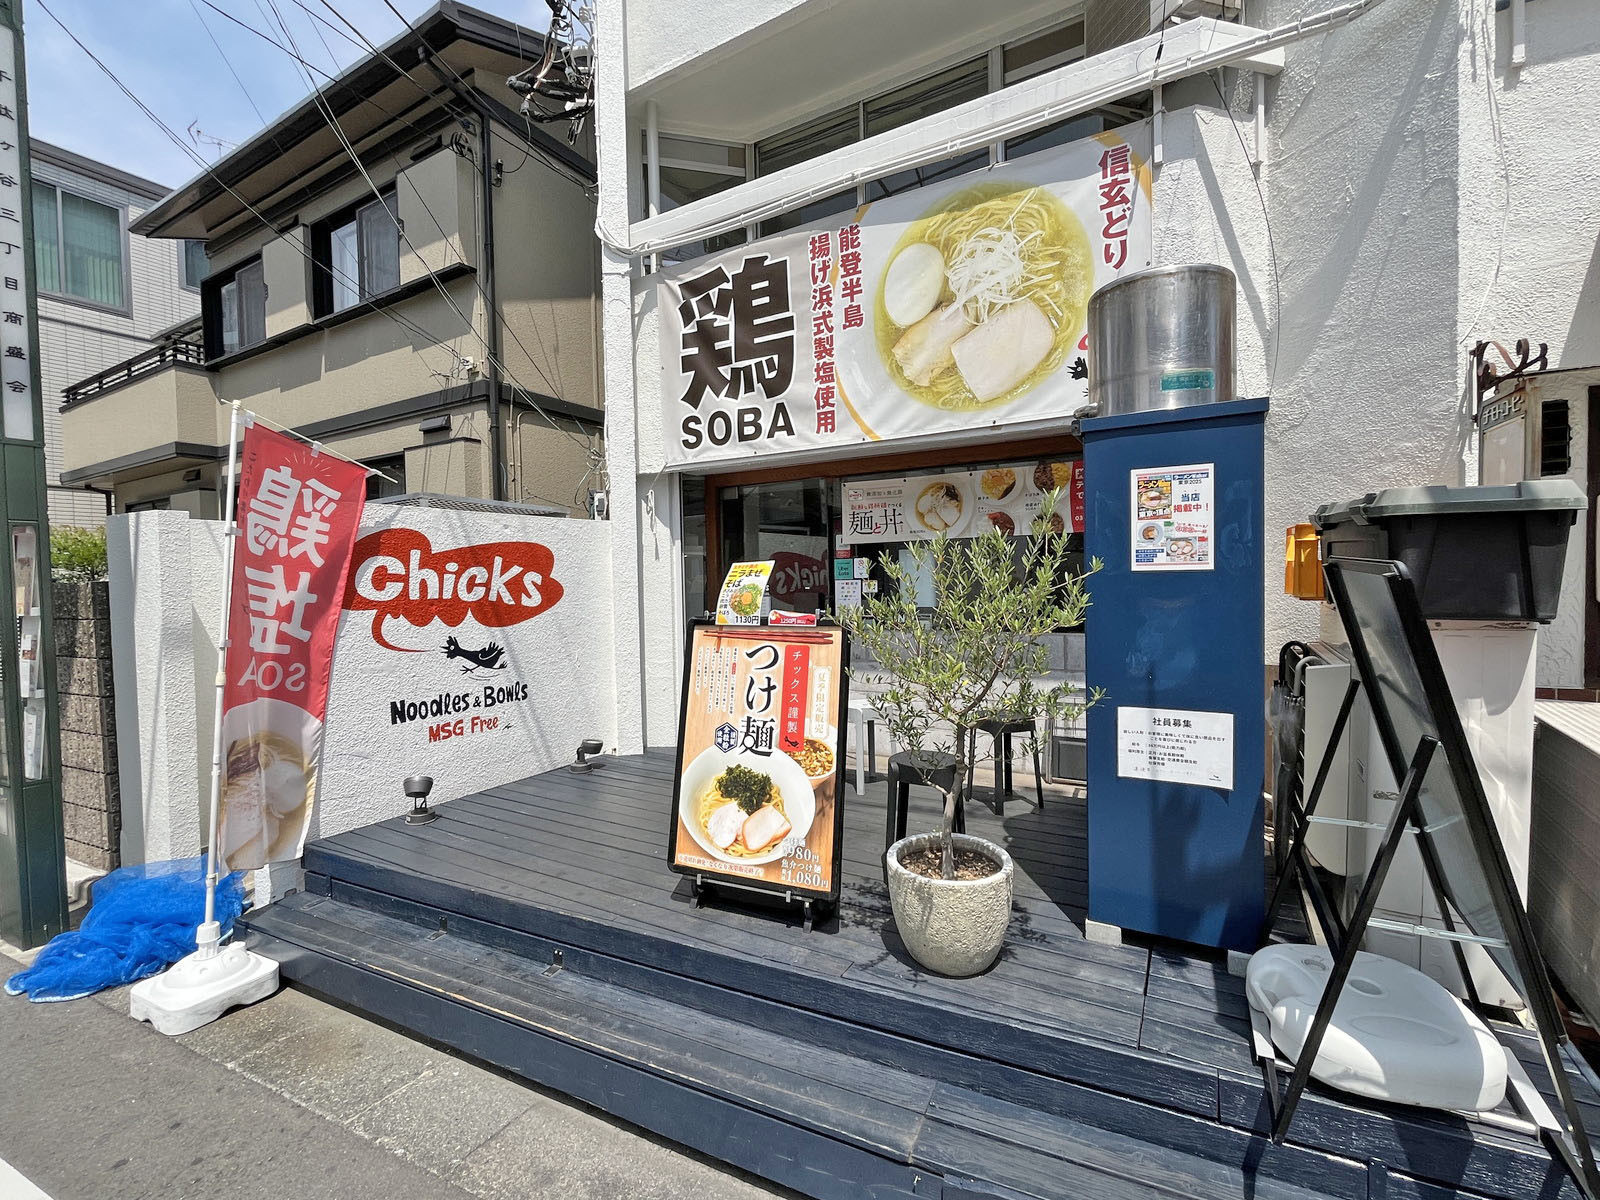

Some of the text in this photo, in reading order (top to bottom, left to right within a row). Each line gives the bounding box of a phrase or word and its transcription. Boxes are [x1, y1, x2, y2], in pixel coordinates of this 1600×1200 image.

[1097, 143, 1132, 271] 信玄どり
[837, 223, 865, 331] 能登半島
[678, 254, 796, 411] 鶏
[808, 233, 837, 435] 揚げ浜式製塩使用
[681, 401, 796, 451] SOBA
[1181, 492, 1201, 502] 当店
[848, 509, 904, 537] 麺と丼
[353, 547, 545, 607] Chicks
[725, 578, 744, 588] そば
[729, 569, 763, 578] ニラまぜ
[735, 615, 760, 624] 1130円
[390, 680, 529, 726] Noodles & Bowls
[739, 644, 780, 757] つけ麺
[786, 650, 803, 734] チックス謹製
[428, 715, 500, 743] MSG Free
[1152, 716, 1193, 729] 社員募集
[781, 859, 822, 873] 魚介つけ麺
[787, 846, 819, 863] 980円
